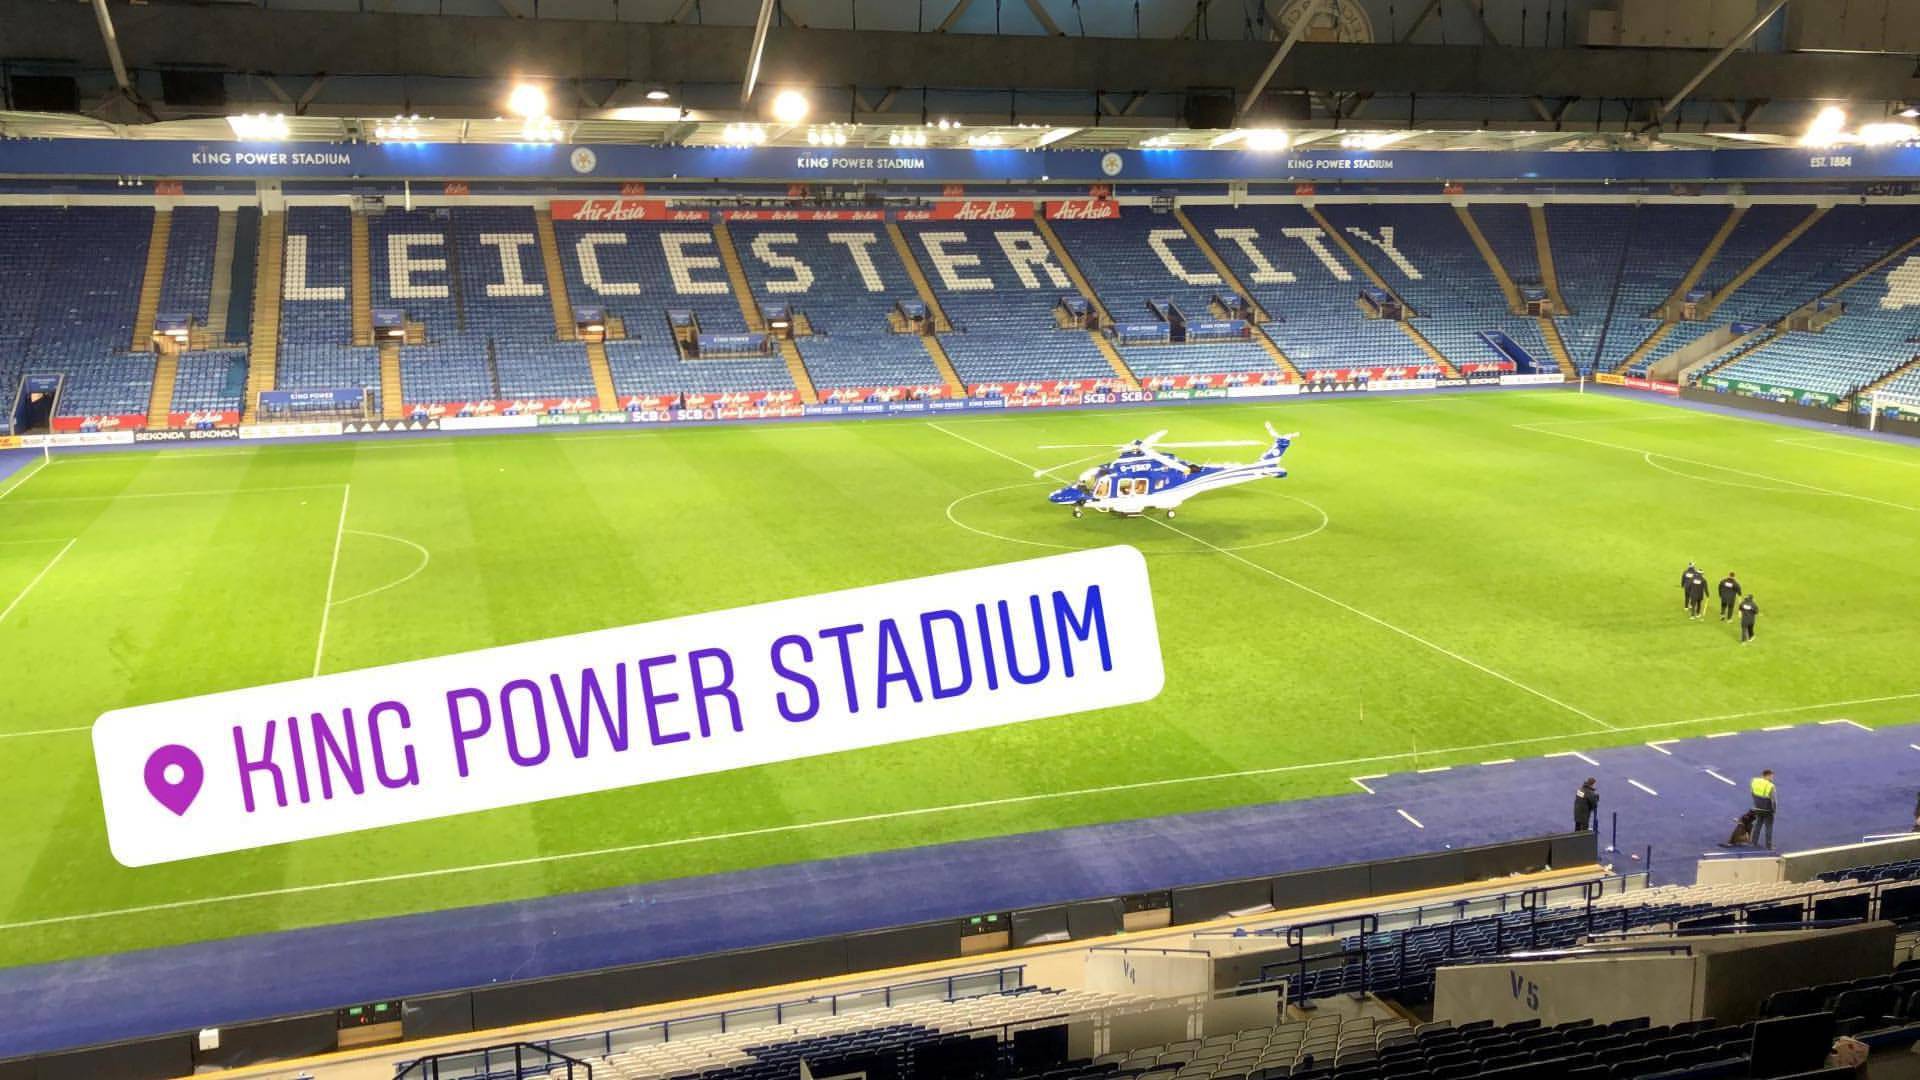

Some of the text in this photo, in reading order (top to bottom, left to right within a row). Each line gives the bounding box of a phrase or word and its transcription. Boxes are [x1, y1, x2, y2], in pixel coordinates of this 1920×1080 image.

[192, 152, 351, 165] KING POWER STADIUM
[797, 157, 925, 169] KING POWER STADIUM
[1287, 158, 1394, 169] KING POWER STADIUM
[1830, 156, 1852, 168] 1884
[1147, 226, 1423, 285] CITY
[283, 230, 1072, 301] LEICESTER
[1083, 393, 1105, 404] SCB
[1121, 391, 1142, 402] SCB
[632, 411, 658, 423] SCB
[677, 409, 702, 421] SCB
[135, 431, 186, 441] SEKONDA
[189, 430, 238, 440] SEKONDA
[1510, 969, 1540, 1011] V5
